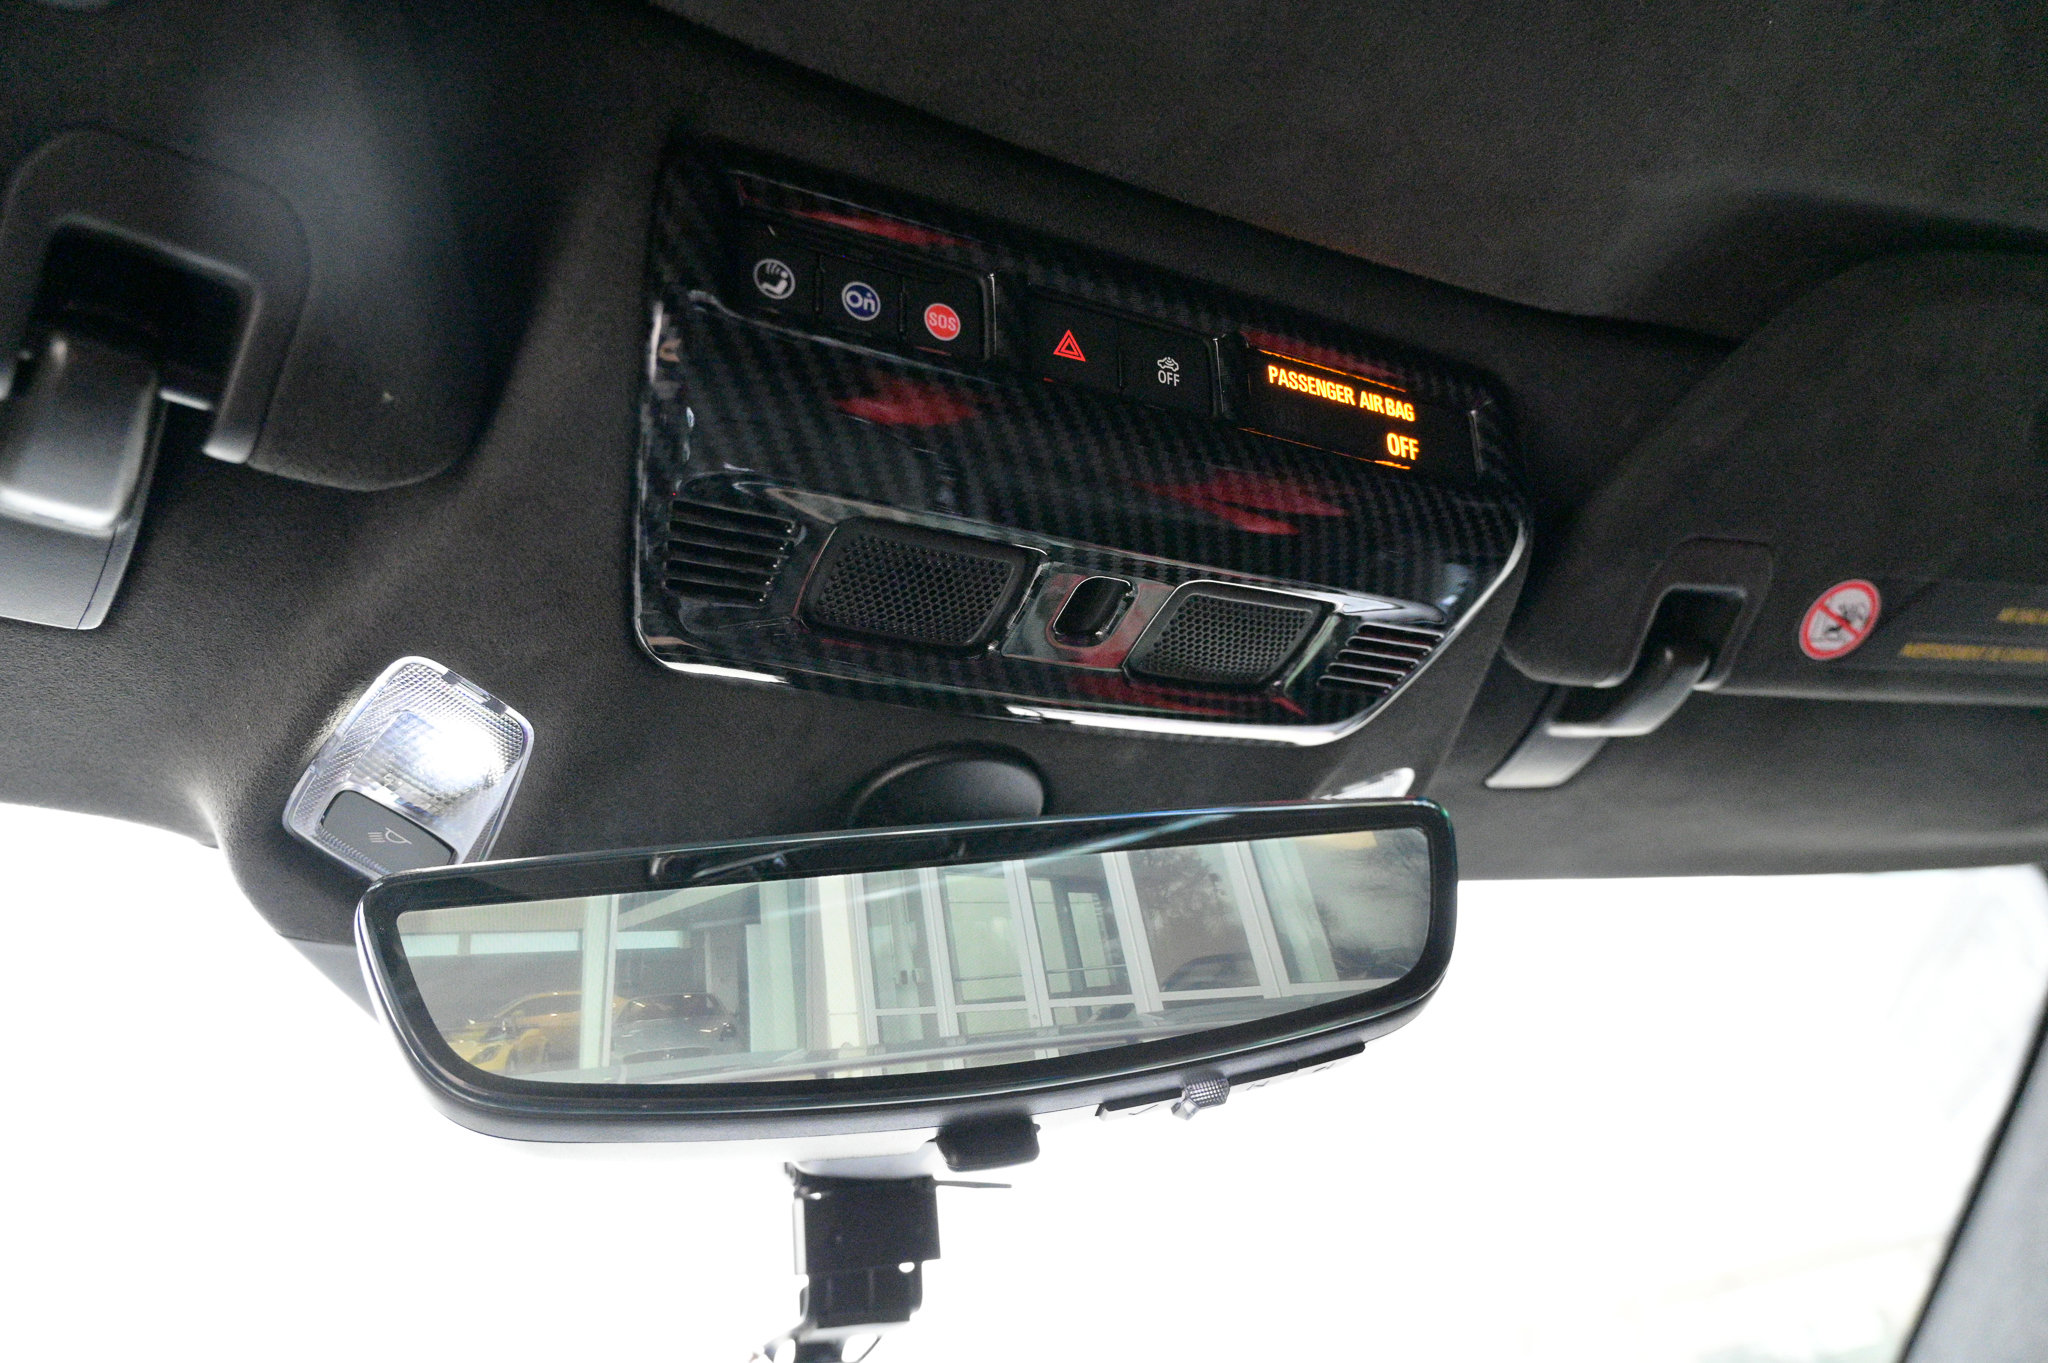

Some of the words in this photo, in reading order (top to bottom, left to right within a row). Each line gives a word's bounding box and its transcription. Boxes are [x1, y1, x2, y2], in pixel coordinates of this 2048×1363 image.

[928, 311, 957, 332] SOS
[1157, 369, 1180, 387] OFF
[1267, 364, 1356, 406] PASSENGER
[1386, 432, 1419, 460] OFF
